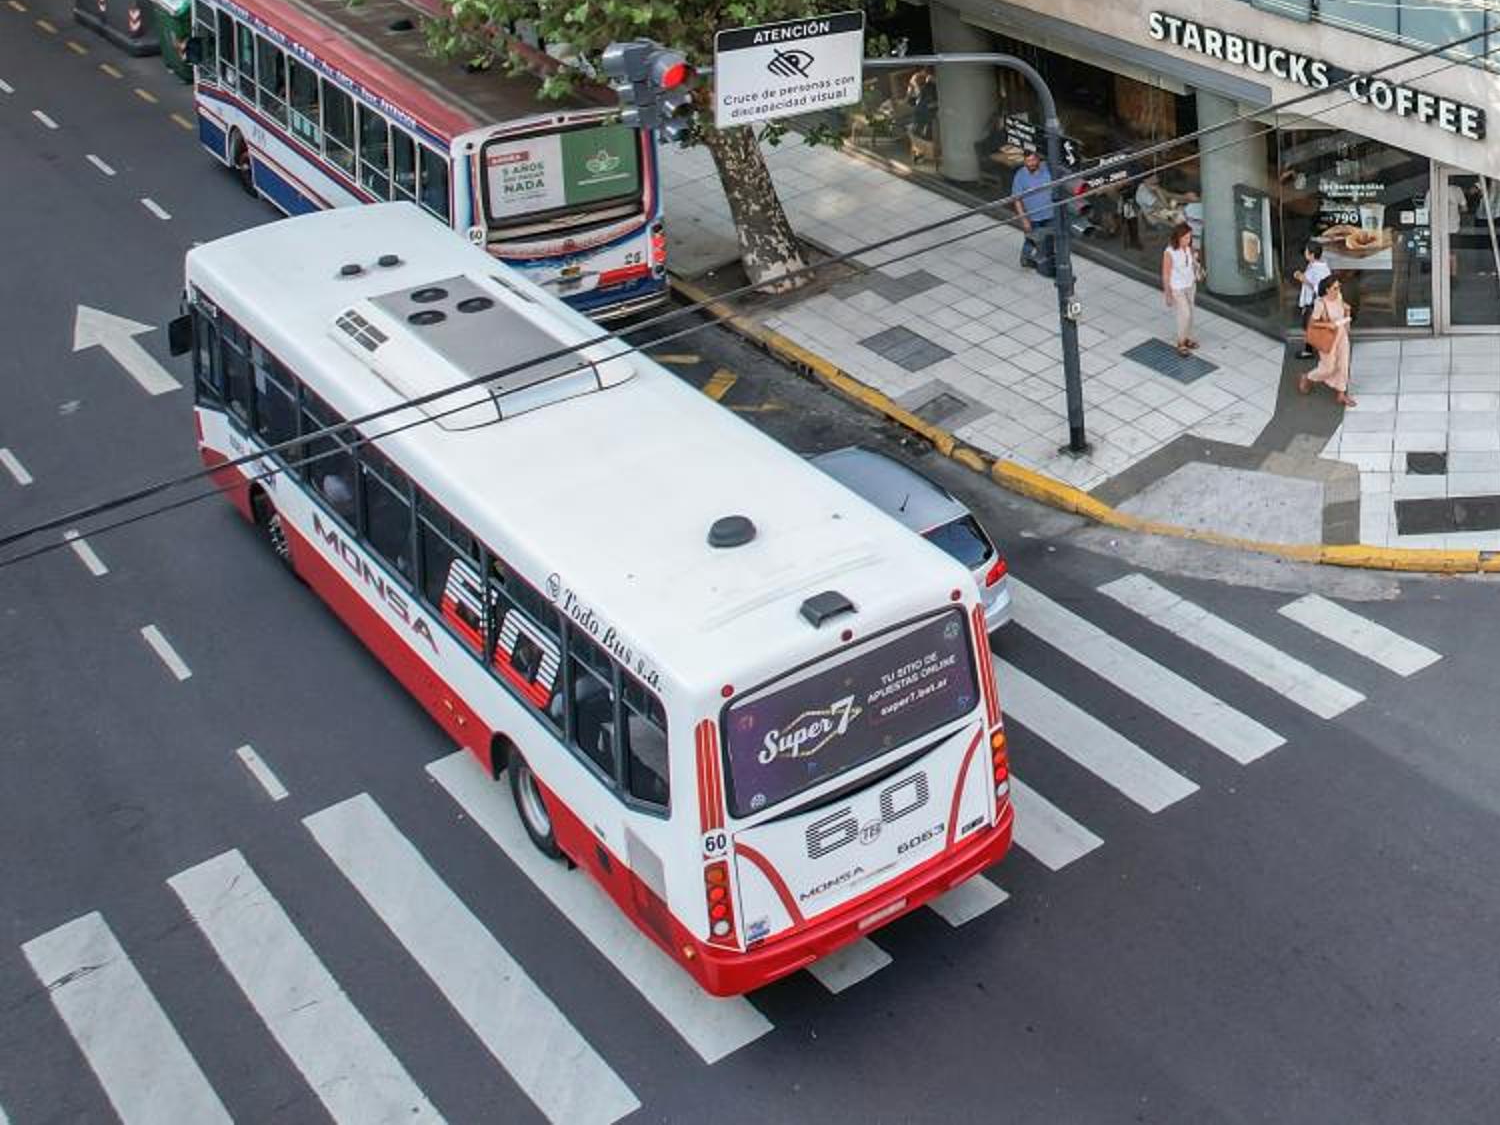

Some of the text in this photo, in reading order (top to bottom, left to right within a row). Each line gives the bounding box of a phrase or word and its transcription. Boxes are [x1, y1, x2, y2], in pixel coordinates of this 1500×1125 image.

[753, 21, 830, 44] ATENCIÓN
[723, 75, 855, 106] Cruce de personas con
[1149, 12, 1481, 141] STARBUCKS COFFEE
[731, 88, 847, 118] discapacidad visual
[504, 179, 545, 194] NADA
[312, 512, 439, 655] MONSA
[564, 587, 599, 635] Todo
[602, 626, 632, 663] Bus
[867, 654, 957, 703] APUESTAS ONLINE
[881, 672, 895, 685] TU
[897, 659, 923, 678] SITIO
[705, 833, 727, 853] 60
[800, 866, 865, 902] MONSA
